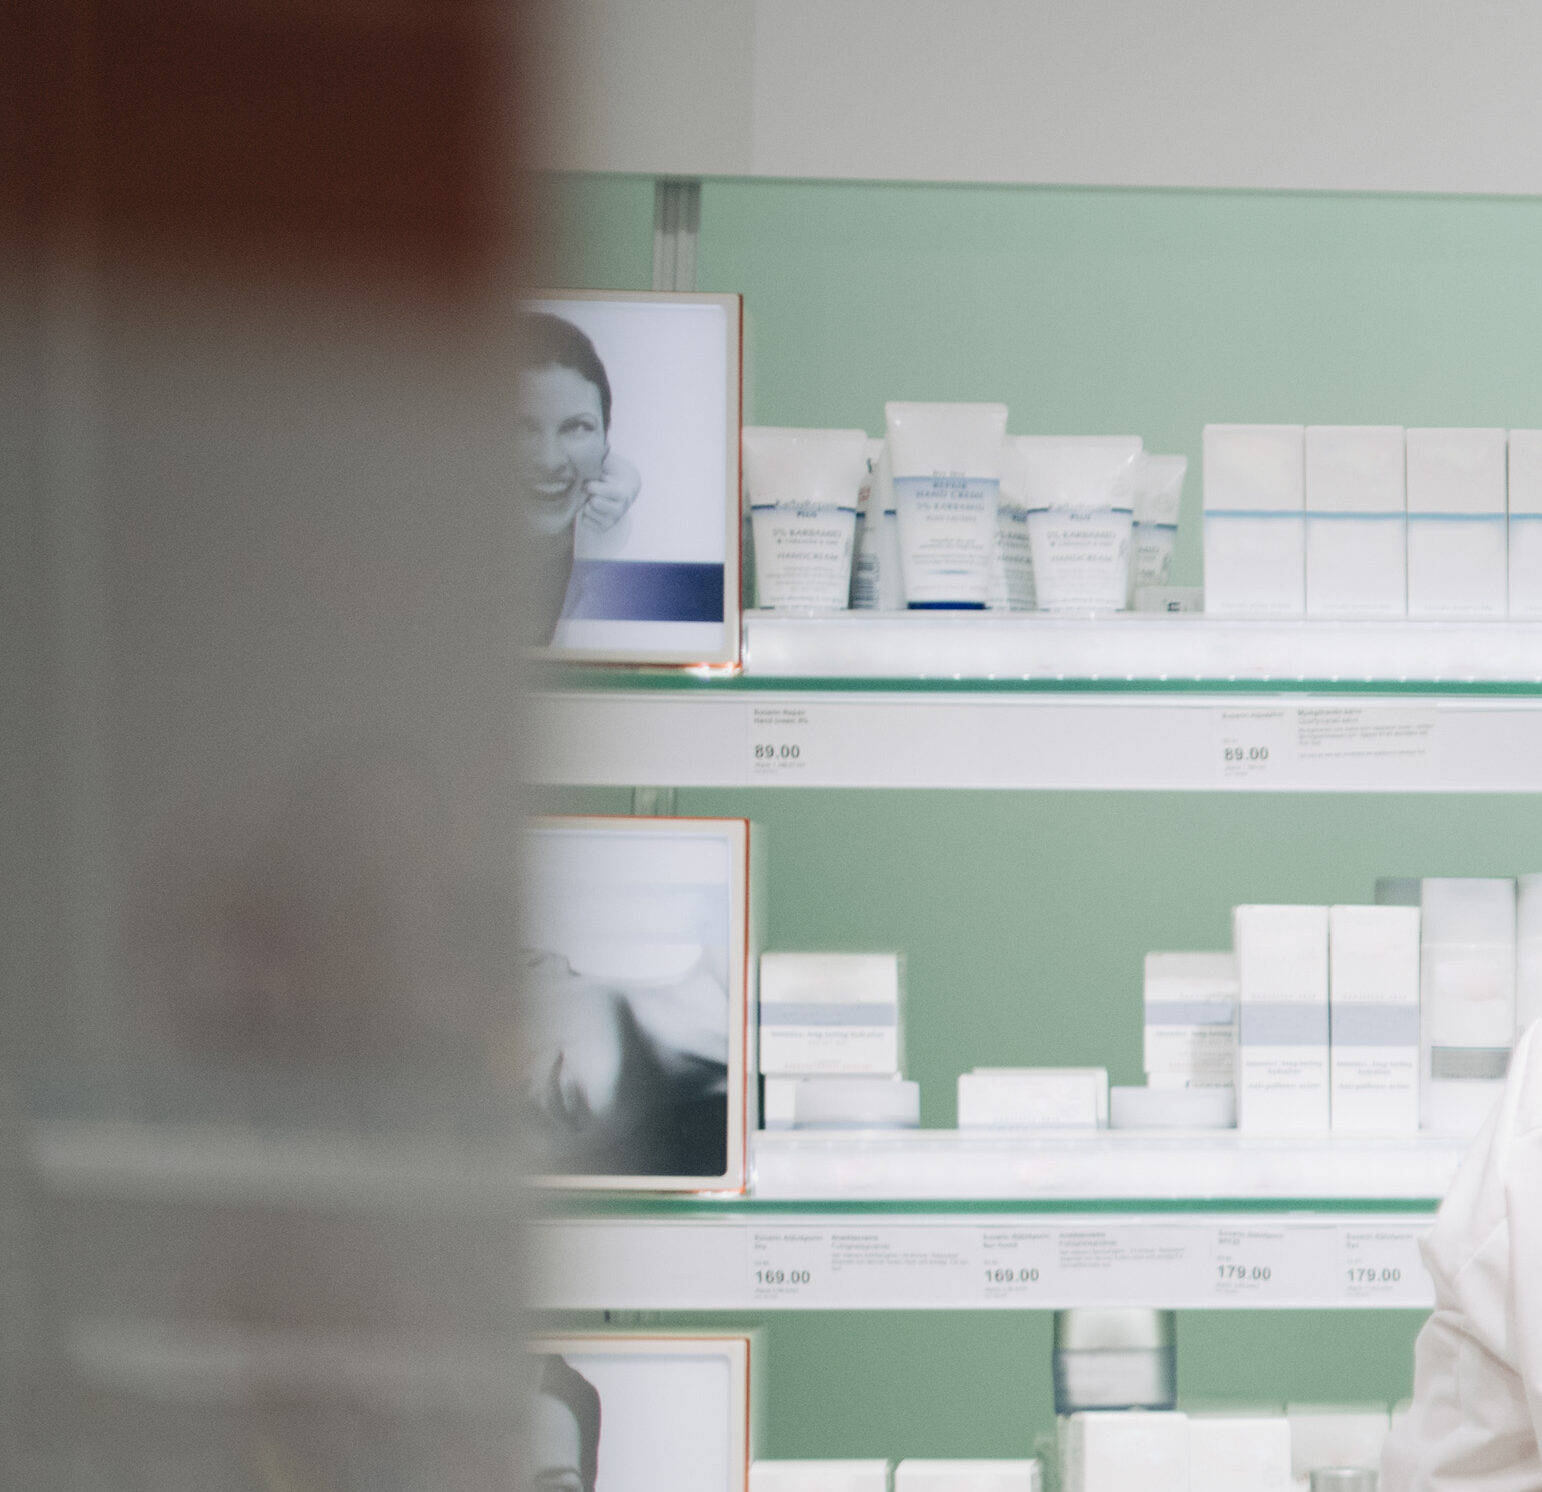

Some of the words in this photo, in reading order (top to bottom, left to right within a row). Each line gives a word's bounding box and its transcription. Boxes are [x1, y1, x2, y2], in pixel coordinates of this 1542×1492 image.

[754, 744, 801, 760] 89.00
[1224, 746, 1270, 761] 89.00
[755, 1269, 811, 1285] 169.00
[985, 1268, 1040, 1283] 169.00
[1217, 1264, 1272, 1281] 179.00
[1347, 1268, 1402, 1282] 179.00
